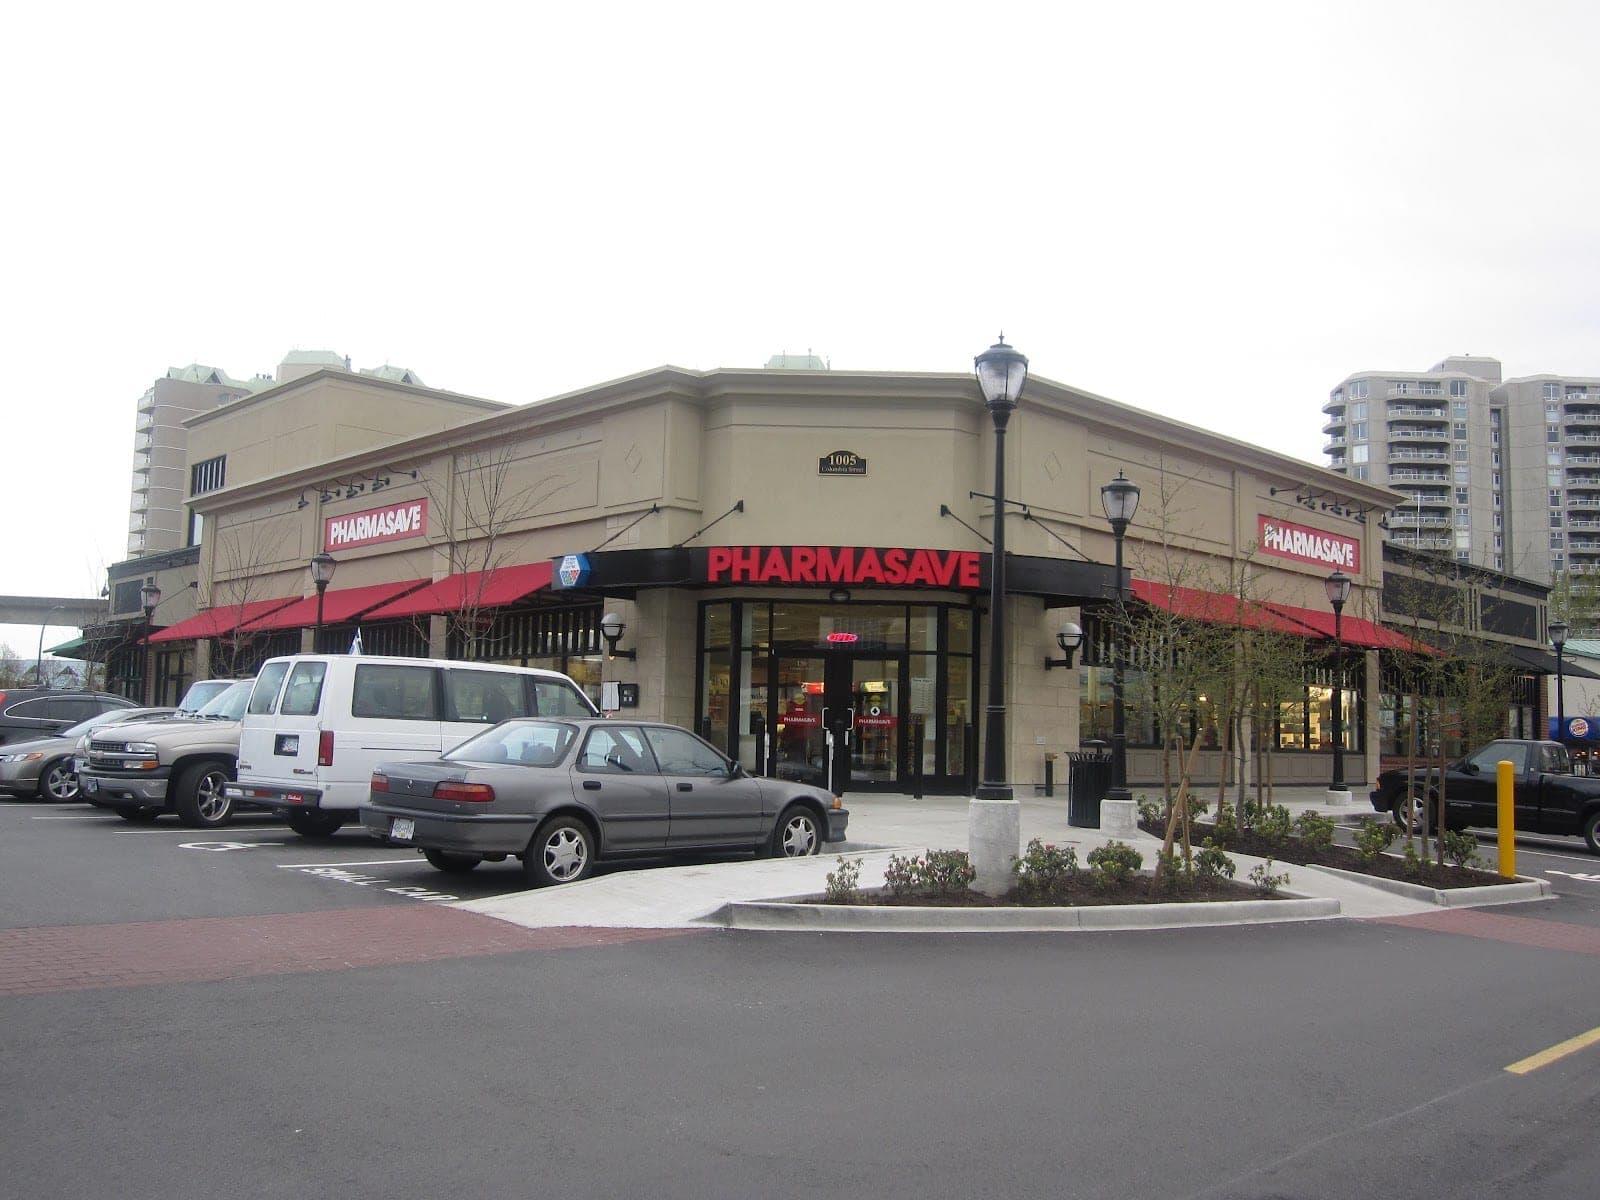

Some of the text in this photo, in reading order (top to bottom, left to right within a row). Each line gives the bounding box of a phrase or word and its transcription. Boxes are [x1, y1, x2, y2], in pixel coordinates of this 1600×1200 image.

[821, 465, 848, 473] Columbia
[829, 454, 857, 466] 1005
[330, 505, 421, 545] PHARMASAVE
[1264, 522, 1354, 567] PHARMASAVE
[707, 546, 981, 587] PHARMASAVE
[383, 886, 460, 901] CAR
